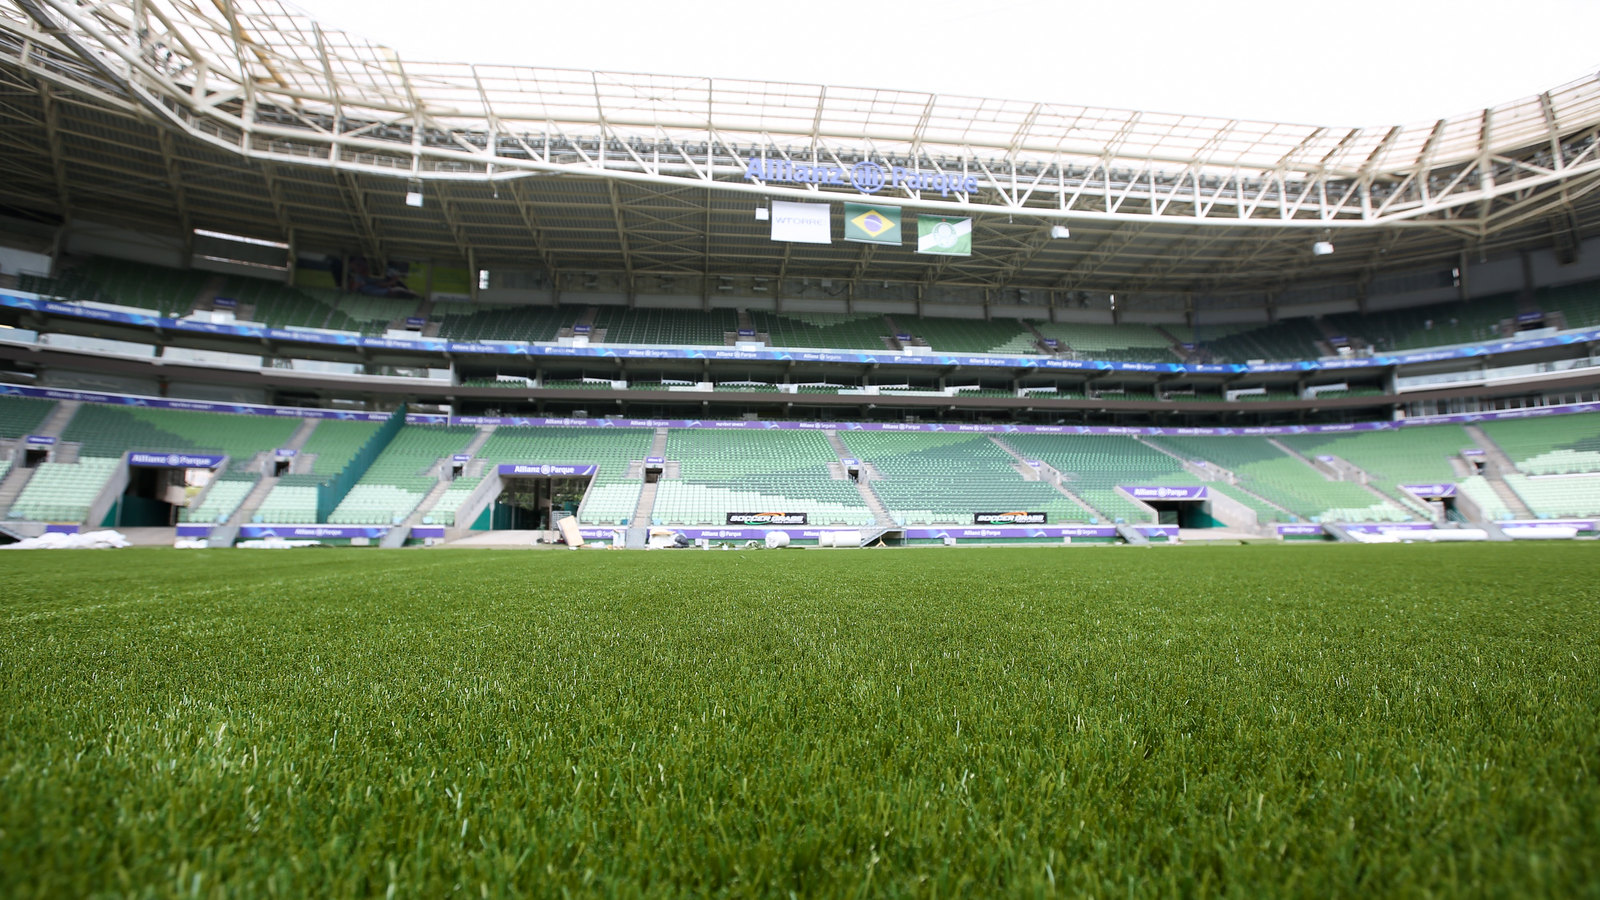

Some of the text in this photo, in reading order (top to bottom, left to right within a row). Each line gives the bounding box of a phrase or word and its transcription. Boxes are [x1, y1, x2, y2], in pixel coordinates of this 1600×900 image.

[744, 157, 978, 197] Allianz Parque
[775, 216, 823, 226] WTORRE
[131, 454, 210, 466] Allianz Parque
[514, 466, 575, 475] Allianz Parque
[1134, 488, 1188, 498] Allianz Parque
